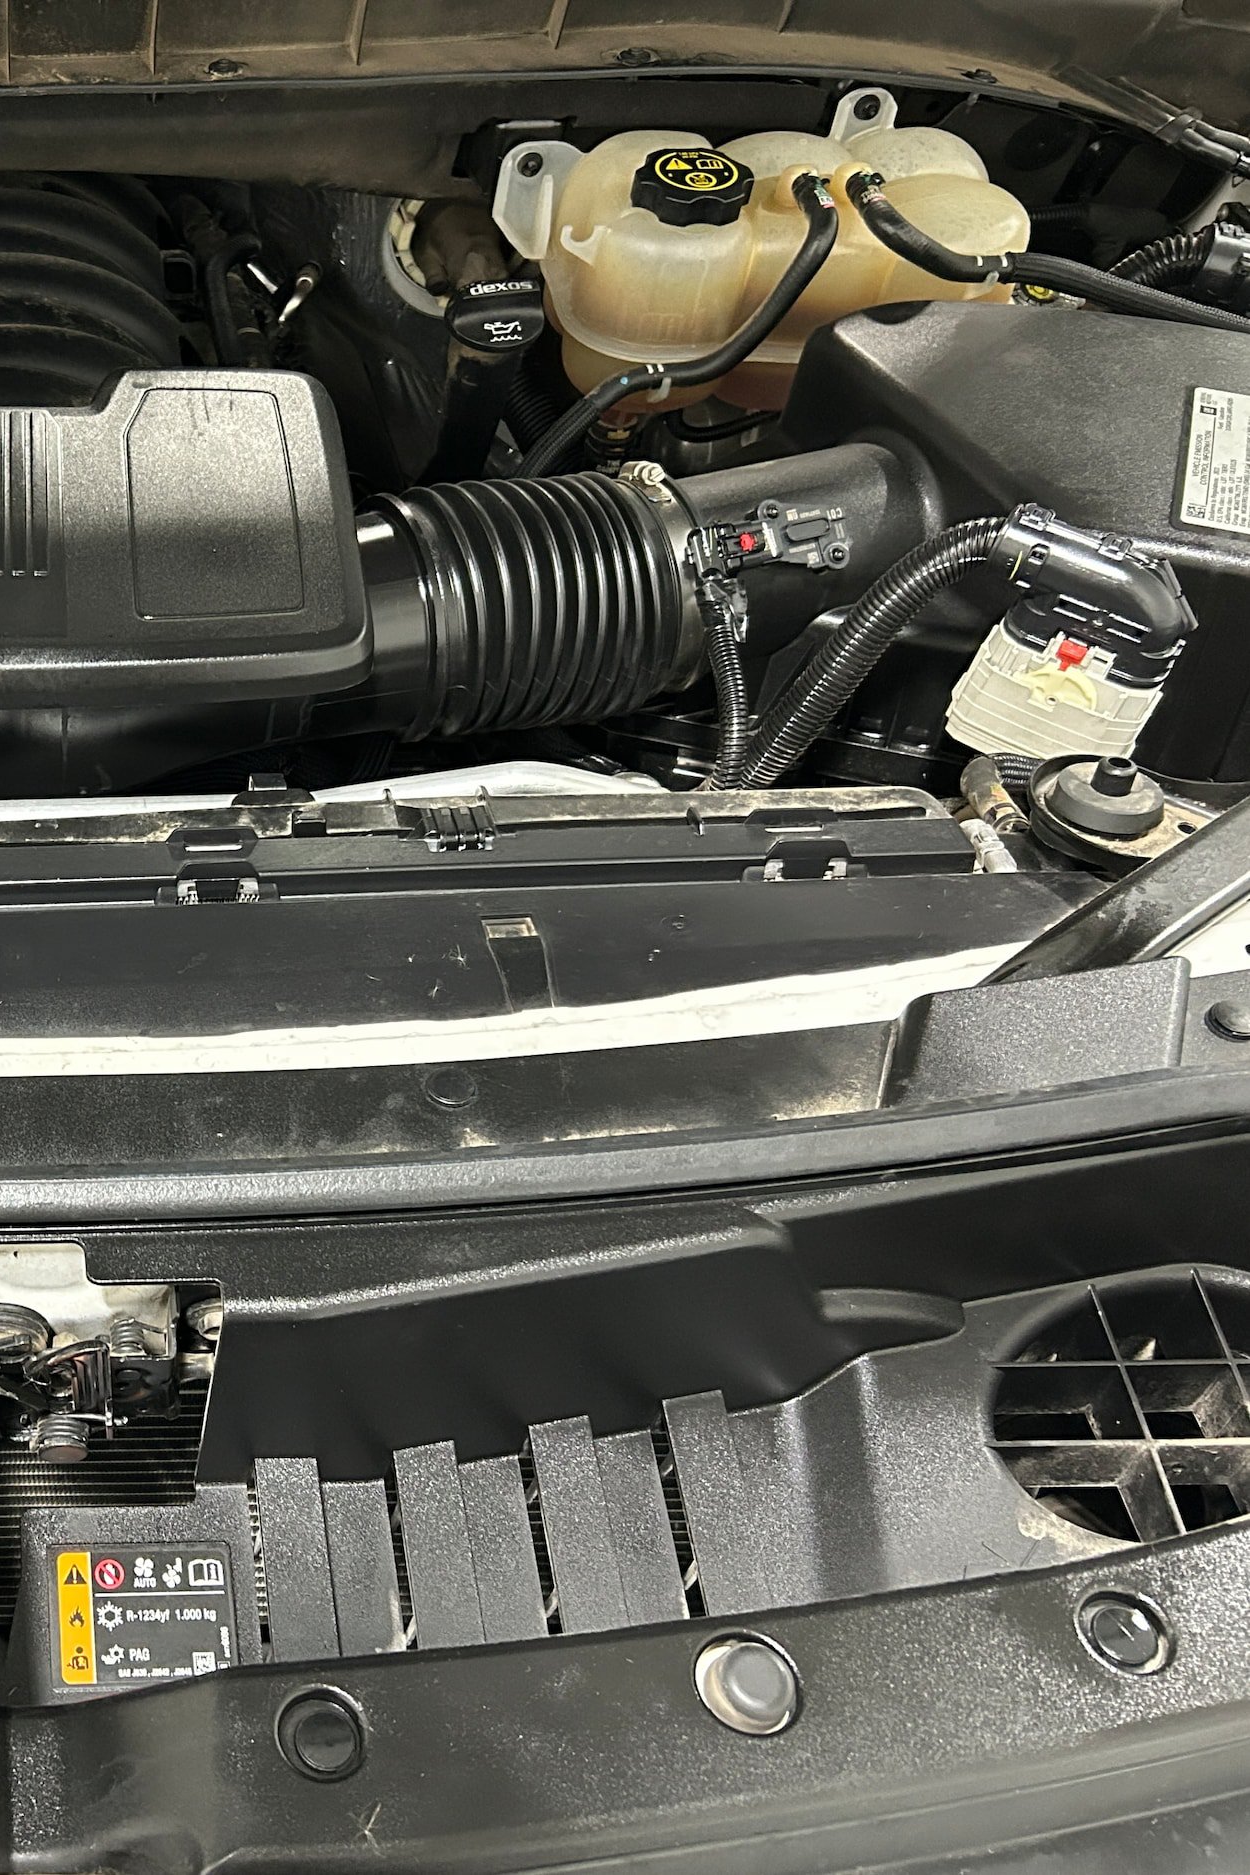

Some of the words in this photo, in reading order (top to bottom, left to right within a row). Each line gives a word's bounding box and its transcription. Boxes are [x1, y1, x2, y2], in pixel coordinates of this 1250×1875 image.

[469, 281, 533, 296] dexos
[133, 1577, 157, 1588] AUTO
[126, 1608, 170, 1624] R-1234yf
[175, 1608, 202, 1621] 1.000
[203, 1608, 217, 1622] kg
[129, 1647, 151, 1661] PAG
